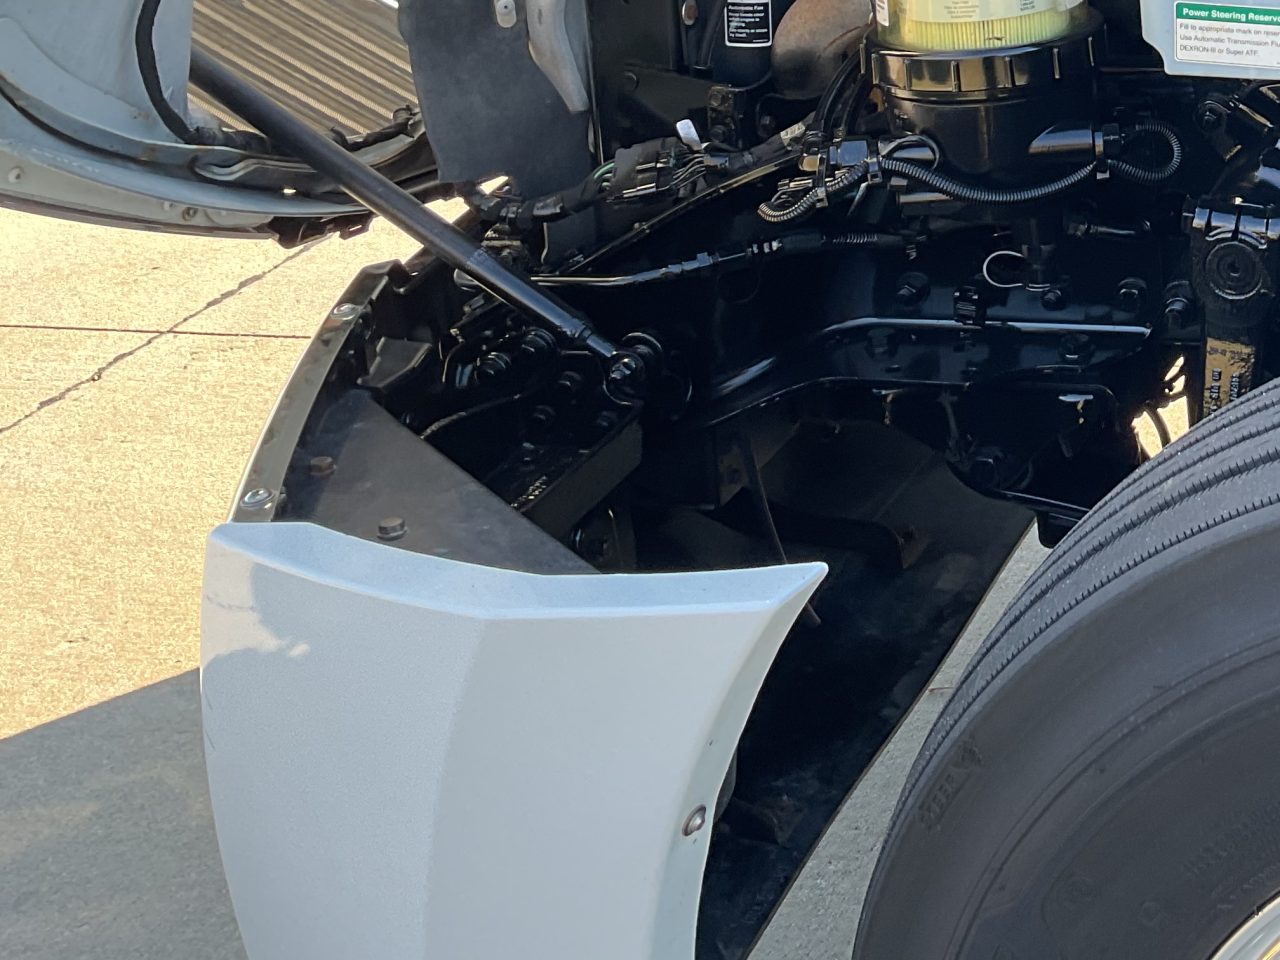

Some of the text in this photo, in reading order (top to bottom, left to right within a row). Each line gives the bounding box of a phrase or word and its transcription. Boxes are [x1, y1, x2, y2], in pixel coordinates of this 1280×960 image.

[1182, 8, 1209, 17] Power
[1211, 10, 1246, 22] Steering
[1180, 22, 1189, 30] Fill
[1198, 25, 1234, 34] appropriate
[1194, 35, 1225, 43] Automatic
[1227, 37, 1269, 47] Transmission
[1226, 48, 1244, 56] Super
